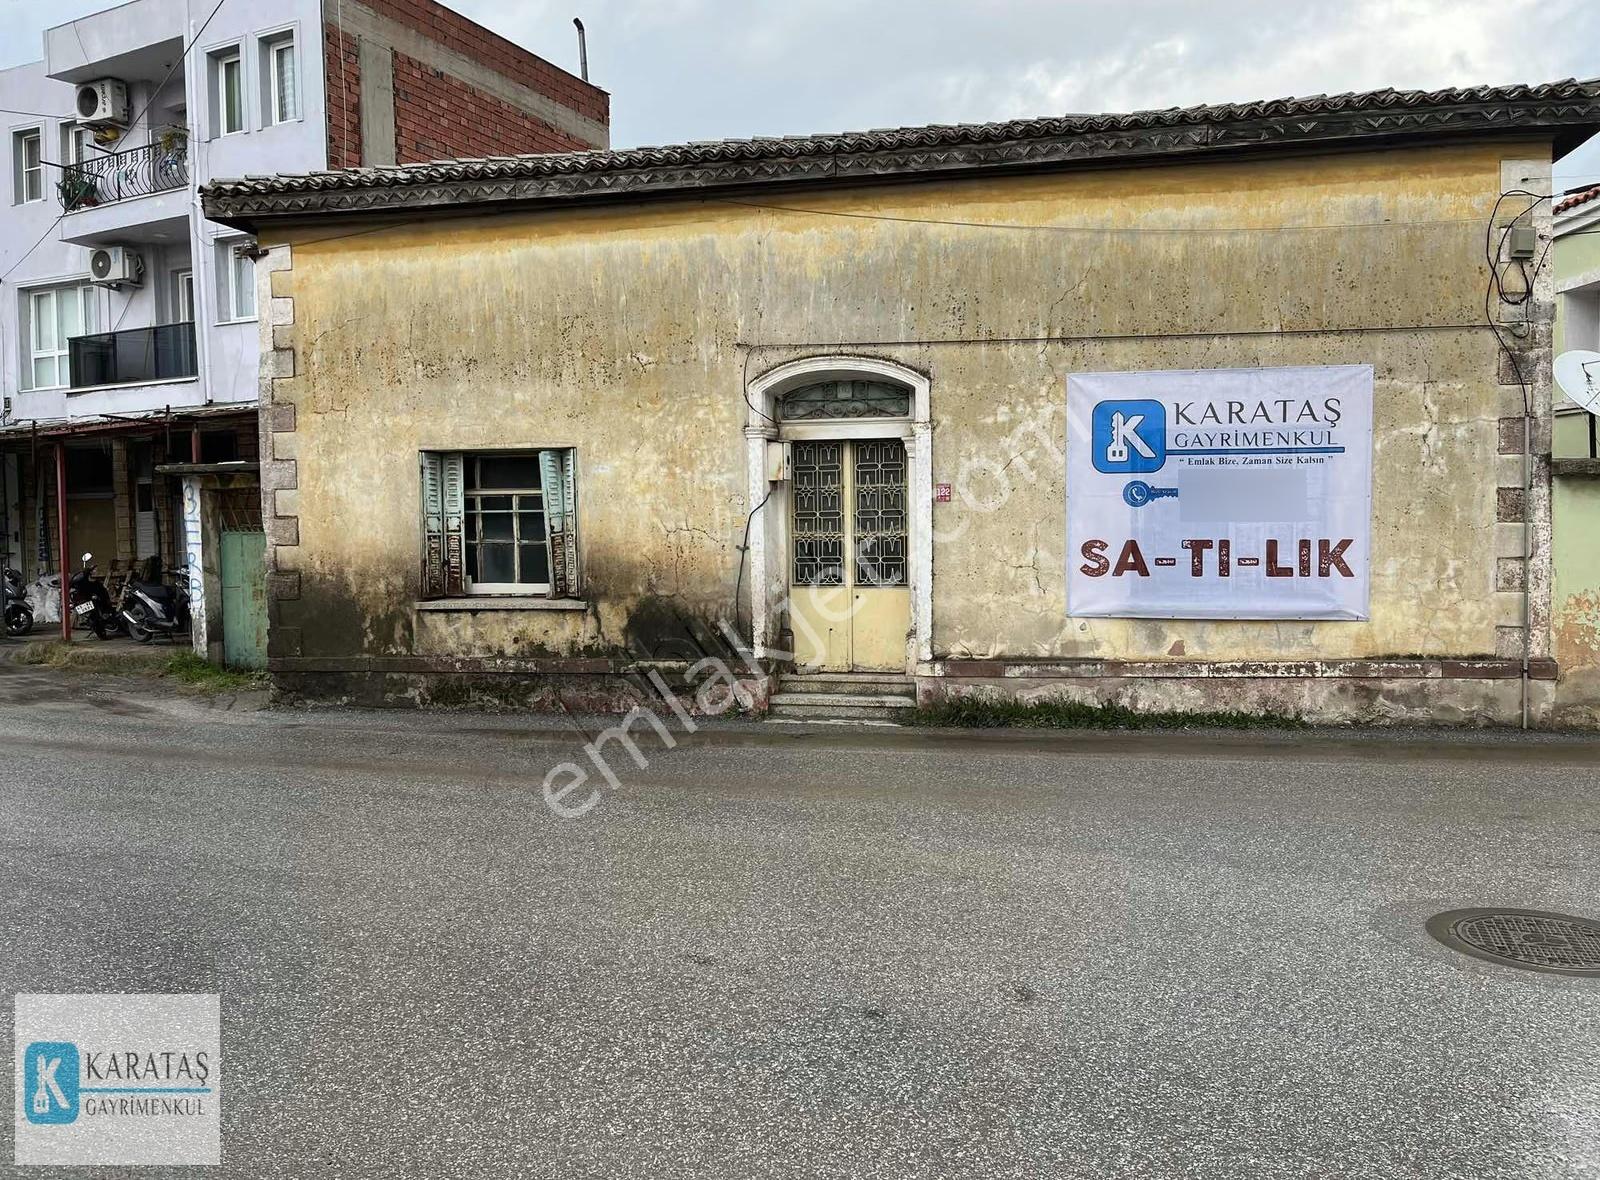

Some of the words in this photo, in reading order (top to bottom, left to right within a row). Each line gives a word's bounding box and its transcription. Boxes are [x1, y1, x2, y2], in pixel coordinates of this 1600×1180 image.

[1173, 398, 1341, 428] KARATAŞ
[1174, 430, 1338, 448] GAYRİMENKUL
[1188, 457, 1215, 466] Emlak
[1242, 457, 1272, 465] Zaman
[1276, 456, 1293, 465] Size
[937, 487, 950, 496] 122
[1079, 539, 1355, 578] SA-TI-LIK
